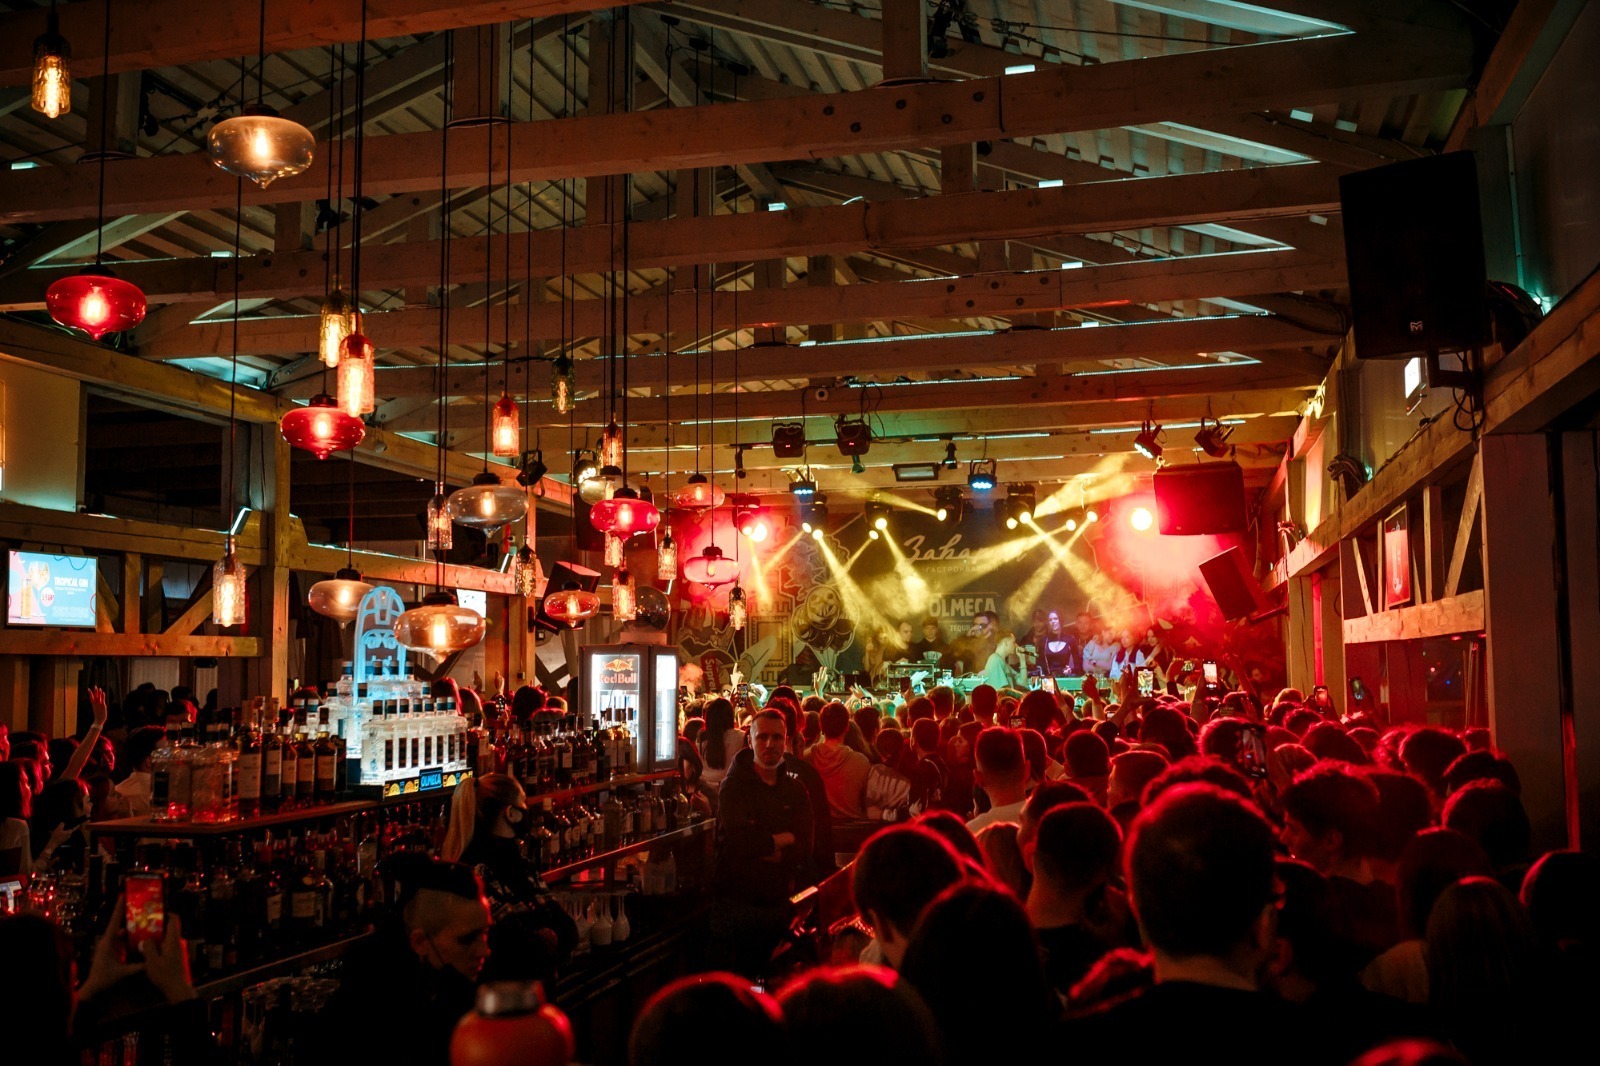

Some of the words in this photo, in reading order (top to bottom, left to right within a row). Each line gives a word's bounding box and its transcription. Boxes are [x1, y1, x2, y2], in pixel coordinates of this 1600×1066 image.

[929, 598, 996, 617] OLMECA
[600, 673, 617, 684] Red
[618, 673, 636, 684] Bull
[705, 659, 717, 690] Supre
[421, 773, 441, 787] OLMECA
